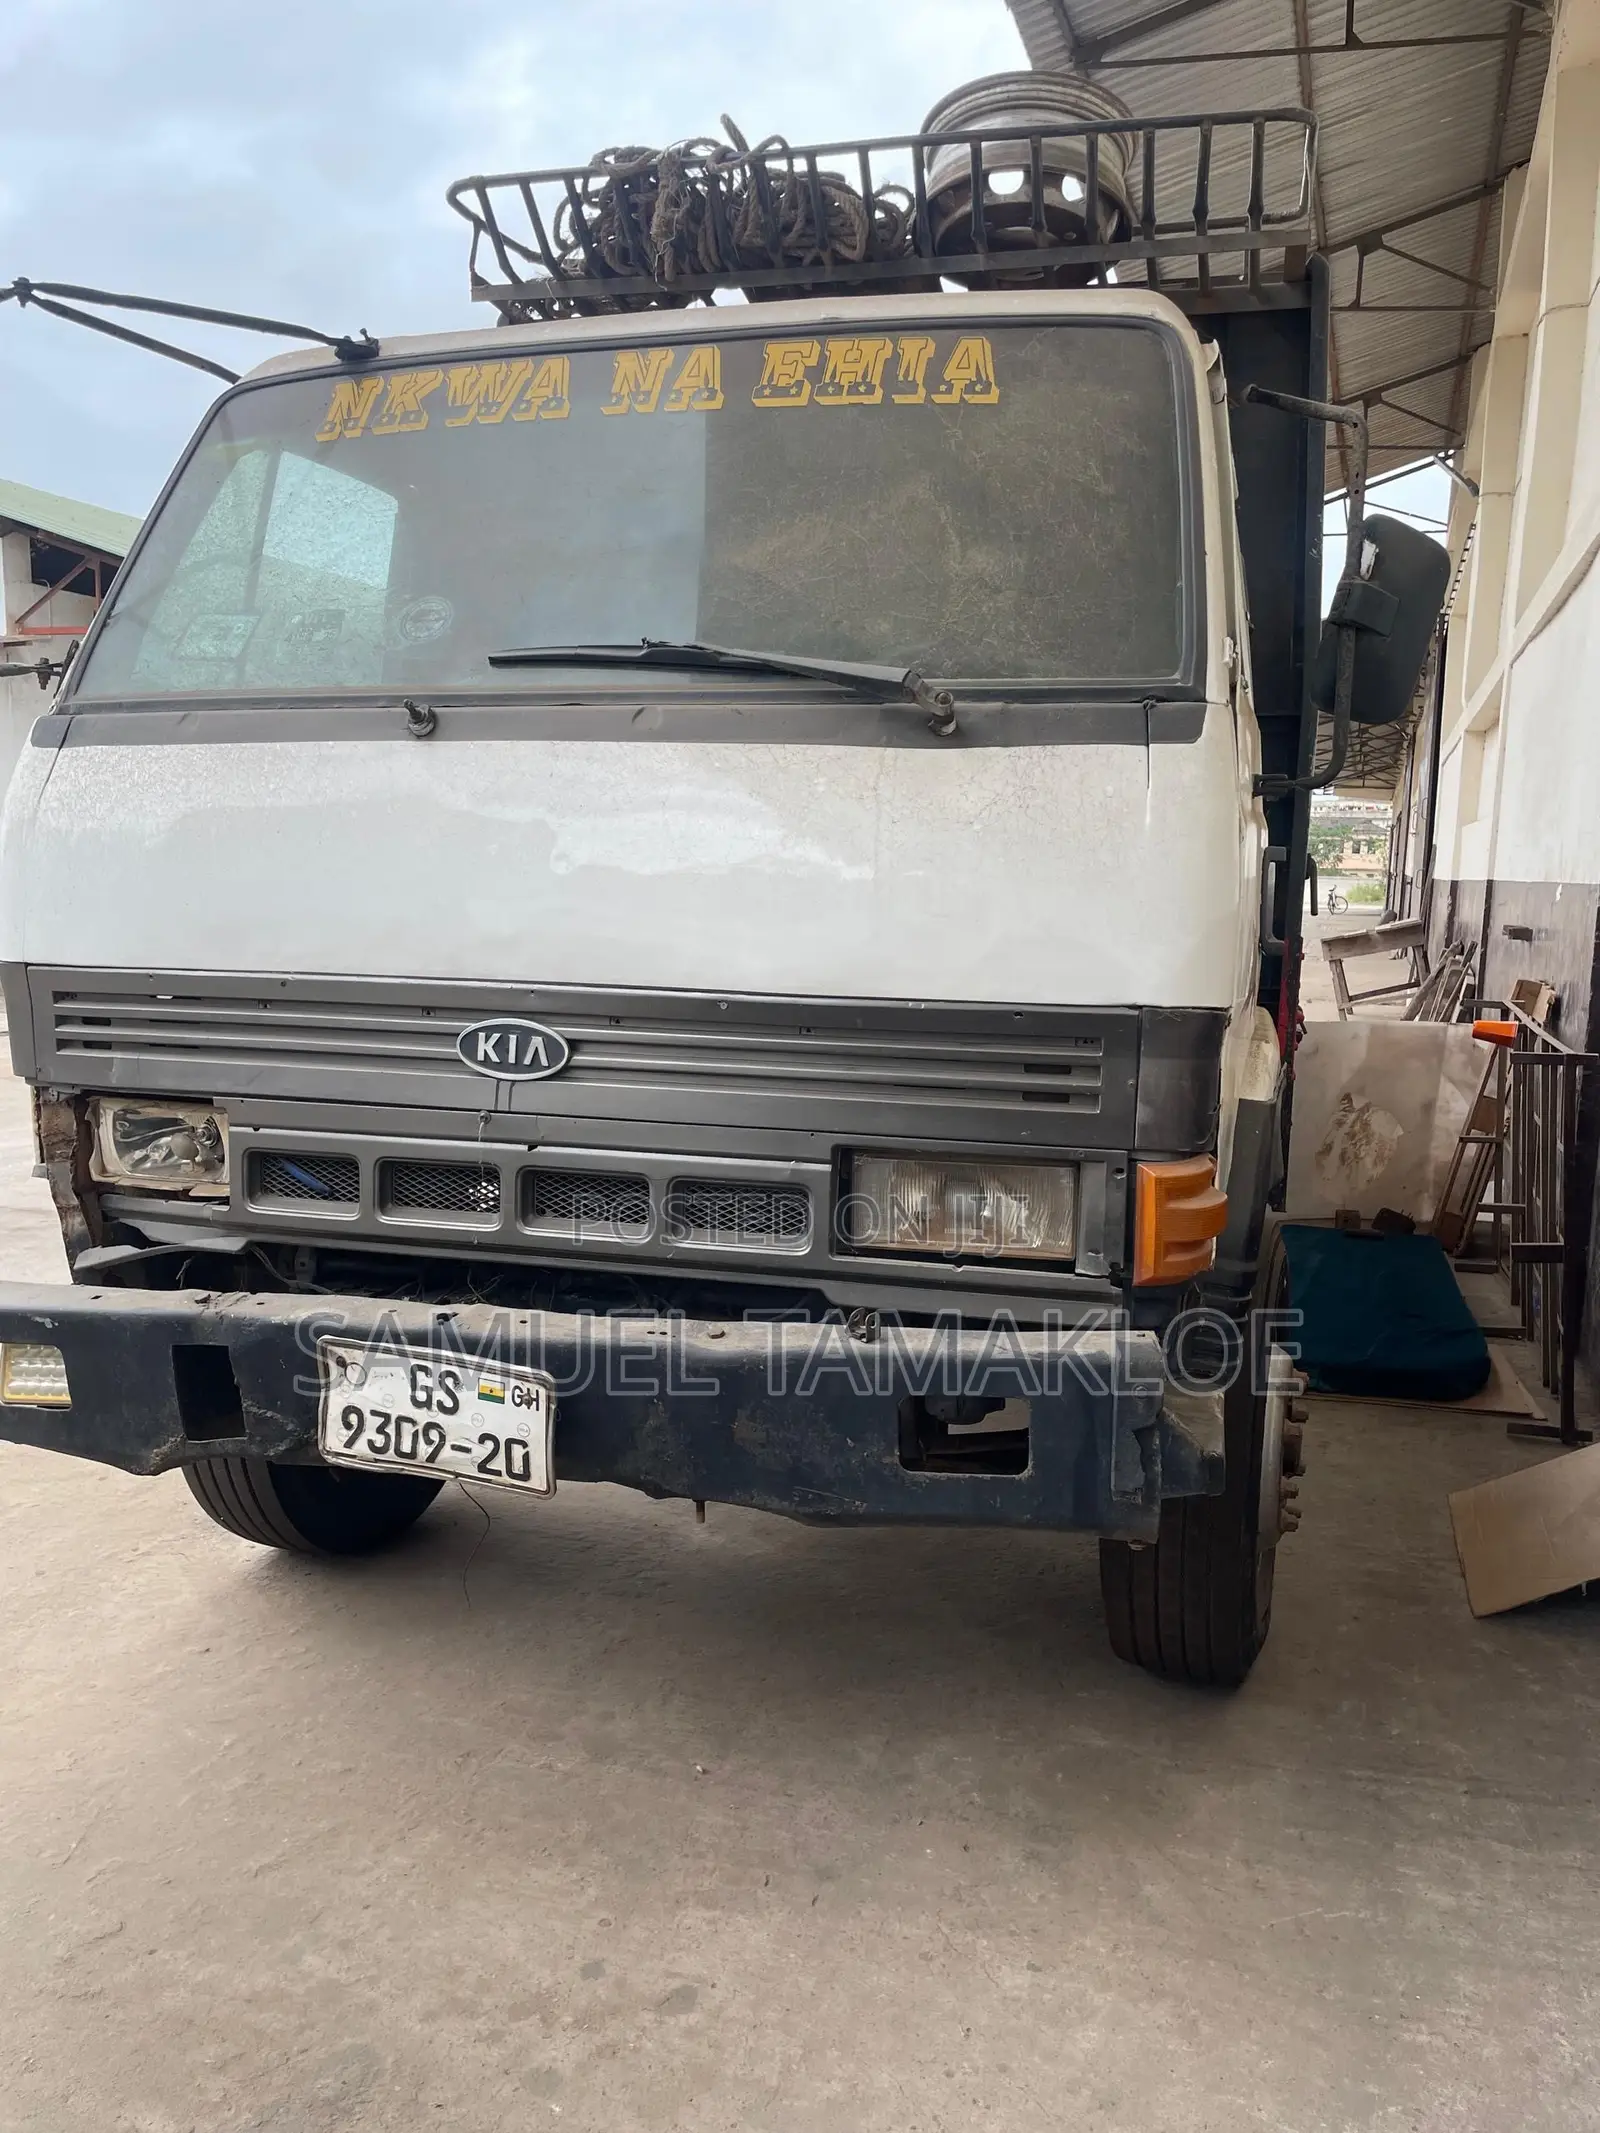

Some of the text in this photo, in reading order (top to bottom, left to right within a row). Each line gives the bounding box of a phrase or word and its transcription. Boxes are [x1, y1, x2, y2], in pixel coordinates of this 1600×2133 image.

[315, 336, 1000, 442] NKWA NA EHIA
[477, 1031, 549, 1067] KIA
[409, 1363, 461, 1416] GS
[510, 1384, 540, 1412] GH
[341, 1404, 531, 1482] 9309-20
